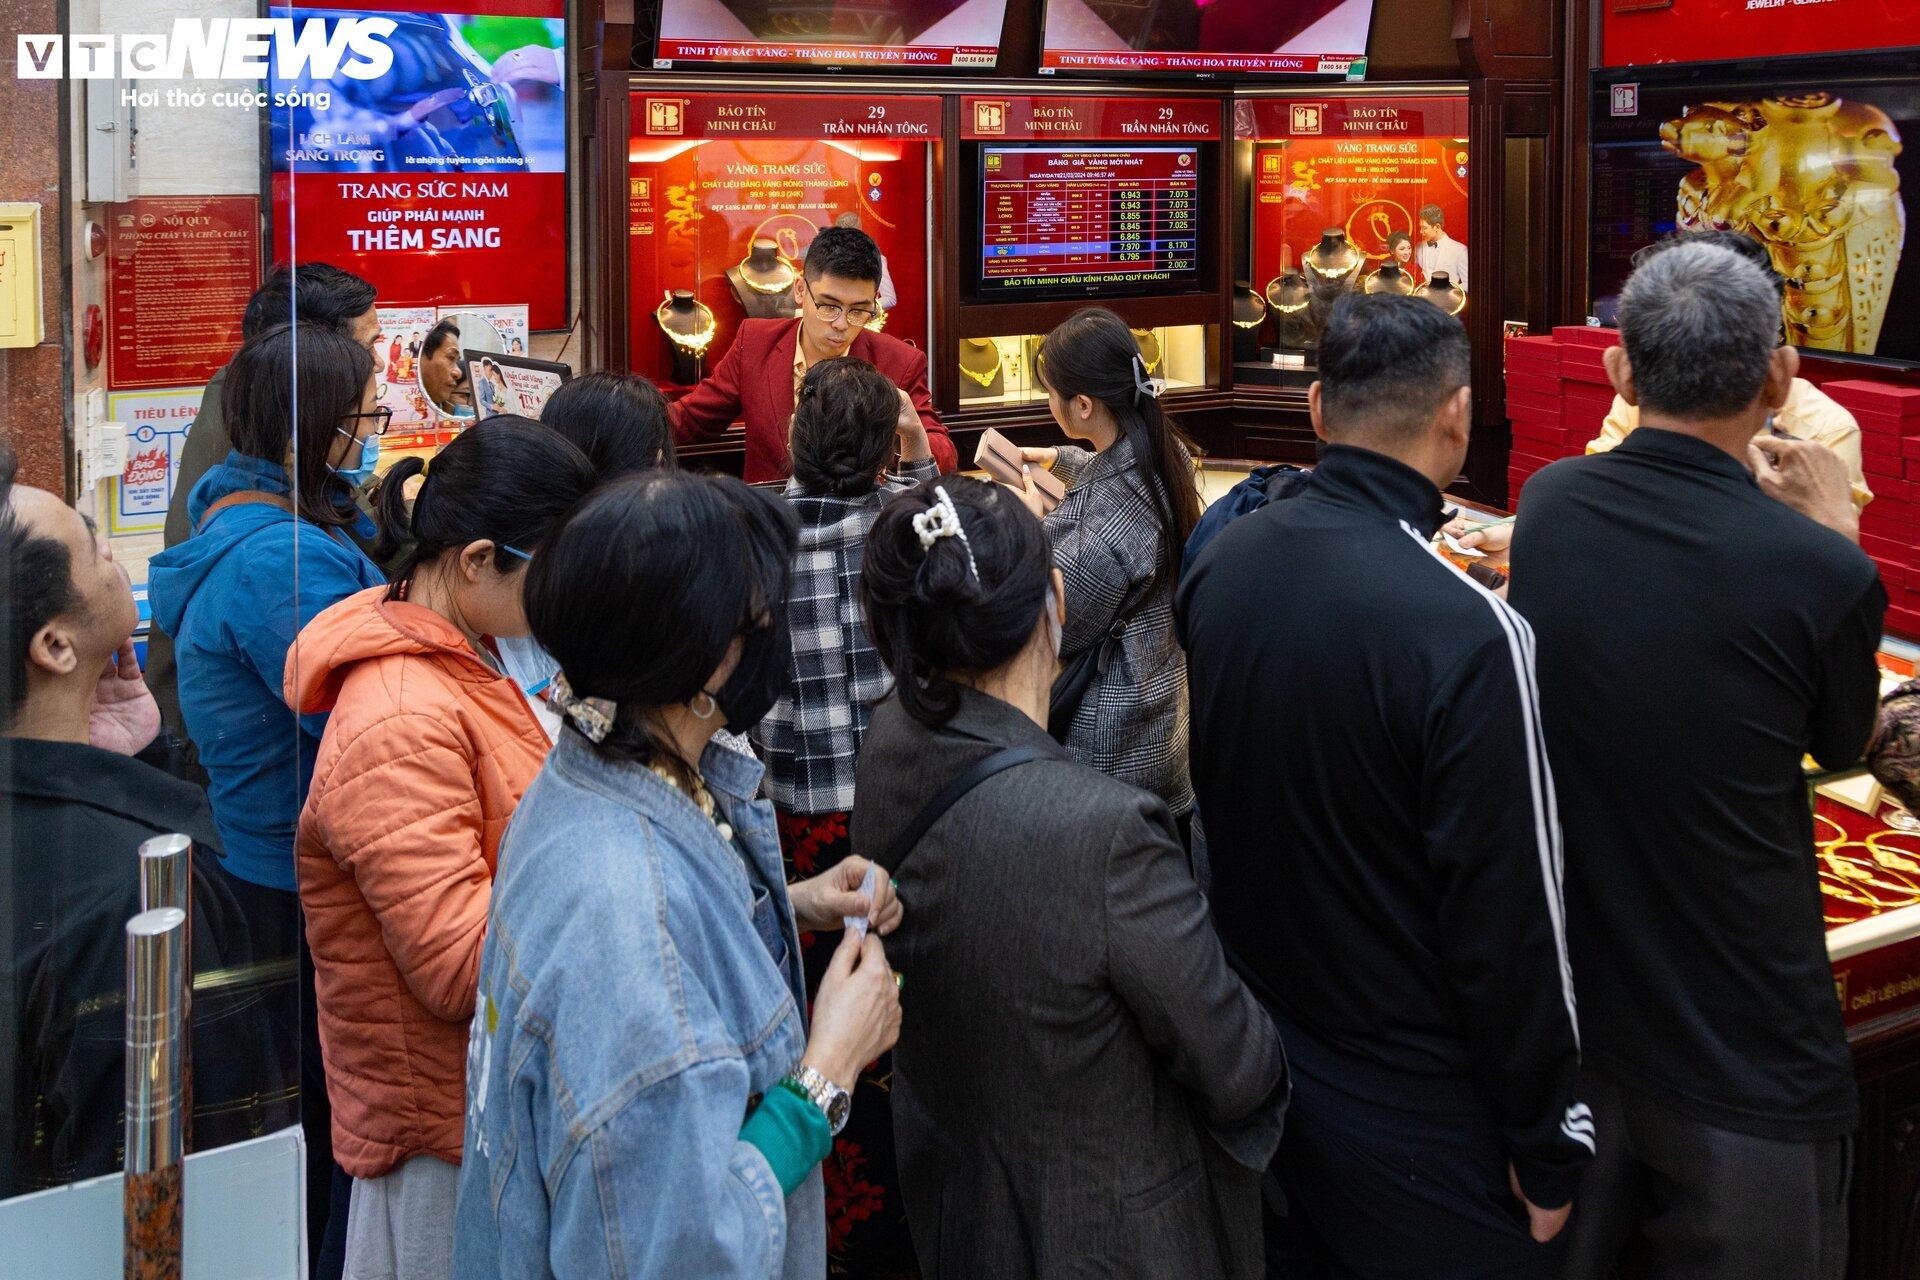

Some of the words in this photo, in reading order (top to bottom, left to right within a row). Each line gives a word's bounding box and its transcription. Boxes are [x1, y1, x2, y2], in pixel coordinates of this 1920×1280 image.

[678, 46, 705, 55] TINH
[708, 46, 730, 56] TÚY
[756, 46, 786, 57] VÀNG
[796, 48, 832, 58] THĂNG
[834, 50, 856, 58] HOA
[859, 50, 900, 60] TRUYỀN
[902, 50, 938, 61] THỐNG
[1130, 56, 1158, 65] VÀNG
[1227, 58, 1266, 67] TRUYỀN
[718, 104, 743, 116] BẢO
[746, 105, 766, 116] TÍN
[868, 106, 885, 119] 29
[1033, 106, 1054, 118] BẢO
[1057, 106, 1073, 118] TÍN
[1158, 107, 1174, 120] 29
[1353, 107, 1376, 118] BẢO
[1379, 106, 1398, 118] TÍN
[707, 121, 739, 130] MINH
[742, 119, 776, 130] CHÂU
[822, 118, 855, 134] TRẦN
[857, 122, 893, 134] NHÂN
[896, 122, 928, 134] TÔNG
[1024, 122, 1052, 131] MINH
[1054, 119, 1082, 131] CHÂU
[1121, 119, 1147, 133] TRẦN
[1150, 122, 1180, 133] NHÂN
[1182, 122, 1209, 133] TÔNG
[1343, 122, 1373, 130] MINH
[1376, 120, 1408, 130] CHÂU
[1336, 142, 1362, 153] VÀNG
[1365, 144, 1396, 152] TRANG
[1398, 142, 1418, 152] SỨC
[286, 150, 329, 162] SANG
[332, 150, 385, 163] TRỌNG
[405, 156, 414, 164] là
[416, 156, 444, 166] những
[446, 156, 470, 166] tuyên
[472, 156, 494, 166] ngôn
[497, 156, 523, 166] không
[1048, 158, 1068, 166] BẢNG
[726, 162, 758, 175] VÀNG
[761, 164, 800, 175] TRANG
[803, 162, 826, 175] SỨC
[338, 182, 411, 199] TRANG
[417, 179, 457, 198] SỨC
[462, 182, 508, 198] NAM
[702, 179, 722, 188] CHẤT
[723, 180, 739, 189] LIỆU
[762, 179, 782, 188] VÀNG
[783, 178, 804, 188] RỒNG
[805, 179, 828, 187] THĂNG
[750, 190, 763, 198] 99.9
[768, 190, 786, 198] 999.9
[786, 190, 803, 198] (24K)
[1121, 202, 1140, 210] 6.943
[1170, 201, 1188, 209] 7.073
[163, 215, 184, 226] NỘI
[367, 208, 402, 223] GIÚP
[405, 208, 439, 222] PHÁI
[442, 210, 484, 224] MẠNH
[1120, 212, 1140, 220] 6.855
[1169, 211, 1188, 219] 7.035
[119, 230, 152, 240] PHÒNG
[154, 230, 181, 239] CHÁY
[182, 230, 194, 238] VÀ
[196, 230, 221, 238] CHỮA
[224, 229, 249, 238] CHÁY
[347, 225, 424, 250] THÊM
[431, 227, 500, 249] SANG
[1168, 261, 1188, 269] 2.002
[1004, 278, 1022, 286] BẢO
[1023, 277, 1036, 285] TÍN
[1060, 275, 1081, 284] CHÂU
[1084, 274, 1101, 282] KÍNH
[1103, 274, 1124, 282] CHÀO
[1125, 273, 1142, 282] QUÝ
[1143, 272, 1170, 280] KHÁCH!
[134, 407, 166, 419] TIÊU
[142, 430, 148, 438] 1
